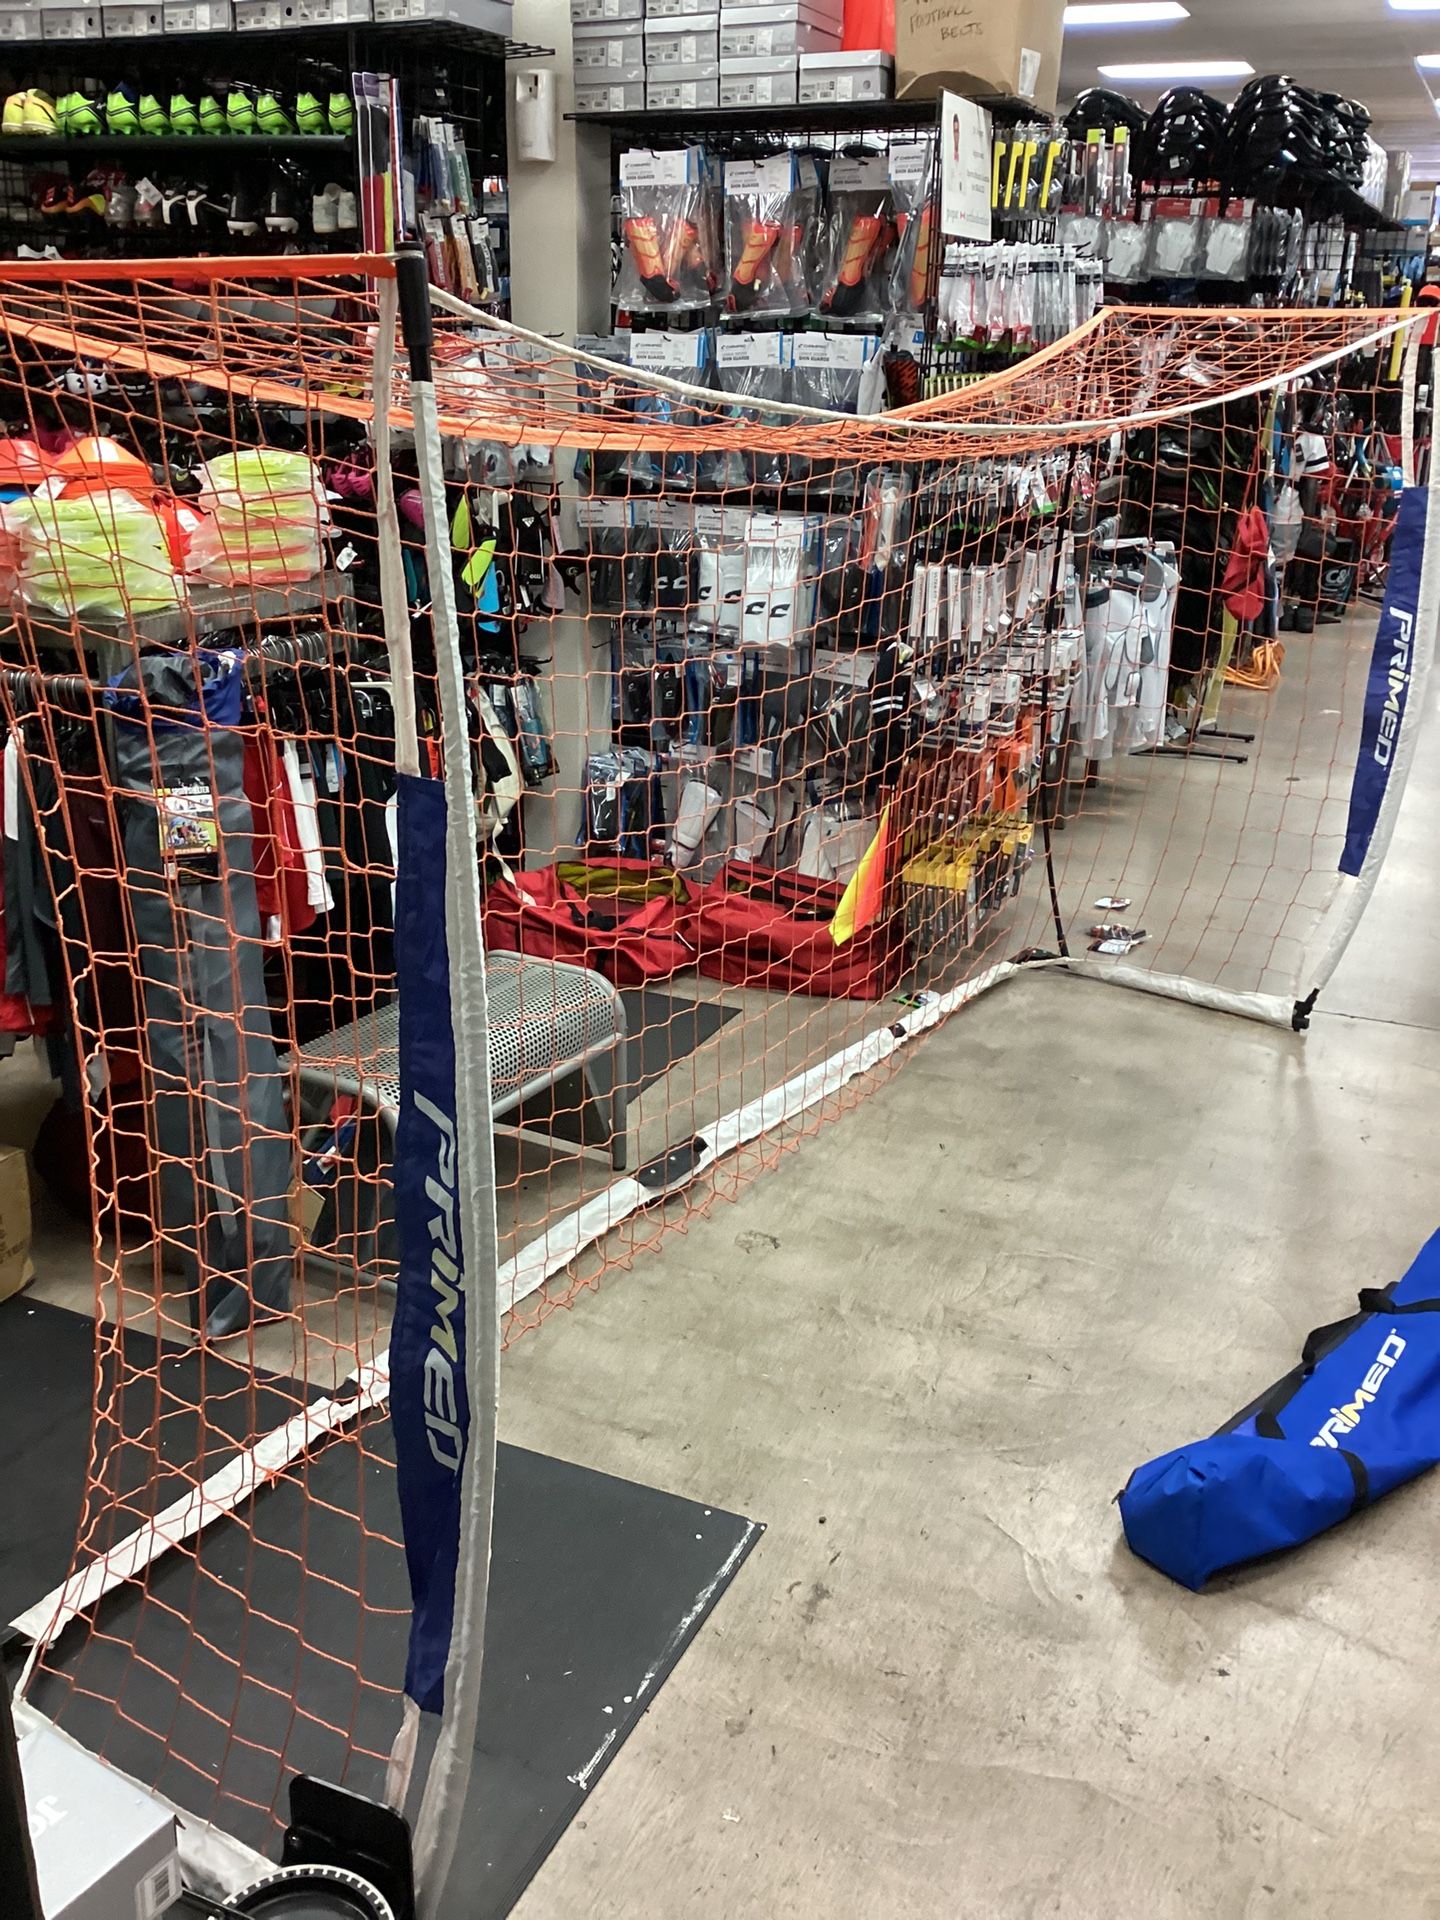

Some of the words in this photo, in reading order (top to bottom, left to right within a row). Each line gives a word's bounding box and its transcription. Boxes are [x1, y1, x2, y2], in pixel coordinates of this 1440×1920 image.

[940, 22, 984, 40] BELTS
[1373, 606, 1414, 769] PRIMED
[413, 1089, 466, 1474] PRIMED
